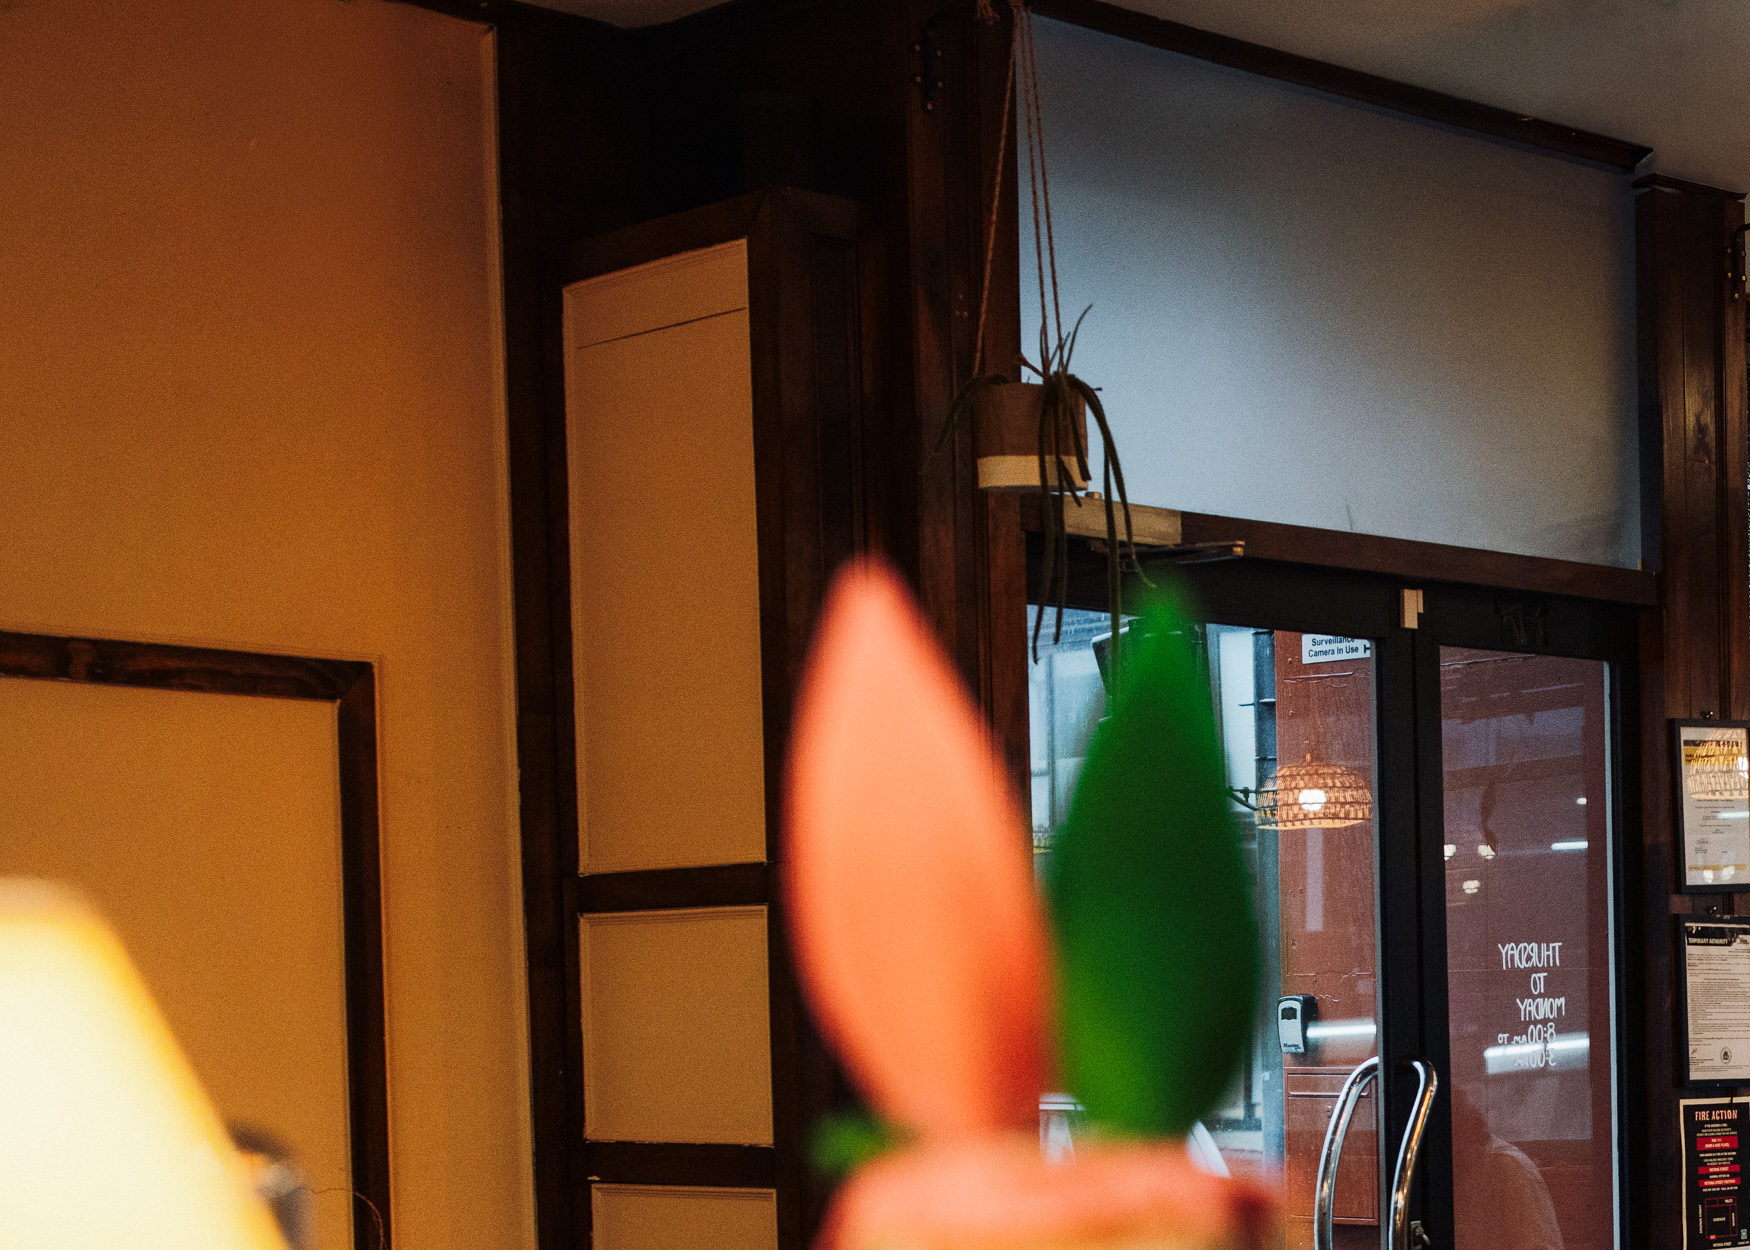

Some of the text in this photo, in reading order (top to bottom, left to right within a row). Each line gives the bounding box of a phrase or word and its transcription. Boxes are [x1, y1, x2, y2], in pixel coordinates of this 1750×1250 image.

[1309, 649, 1335, 657] Camera
[1695, 1109, 1738, 1121] FIRE ACTION
